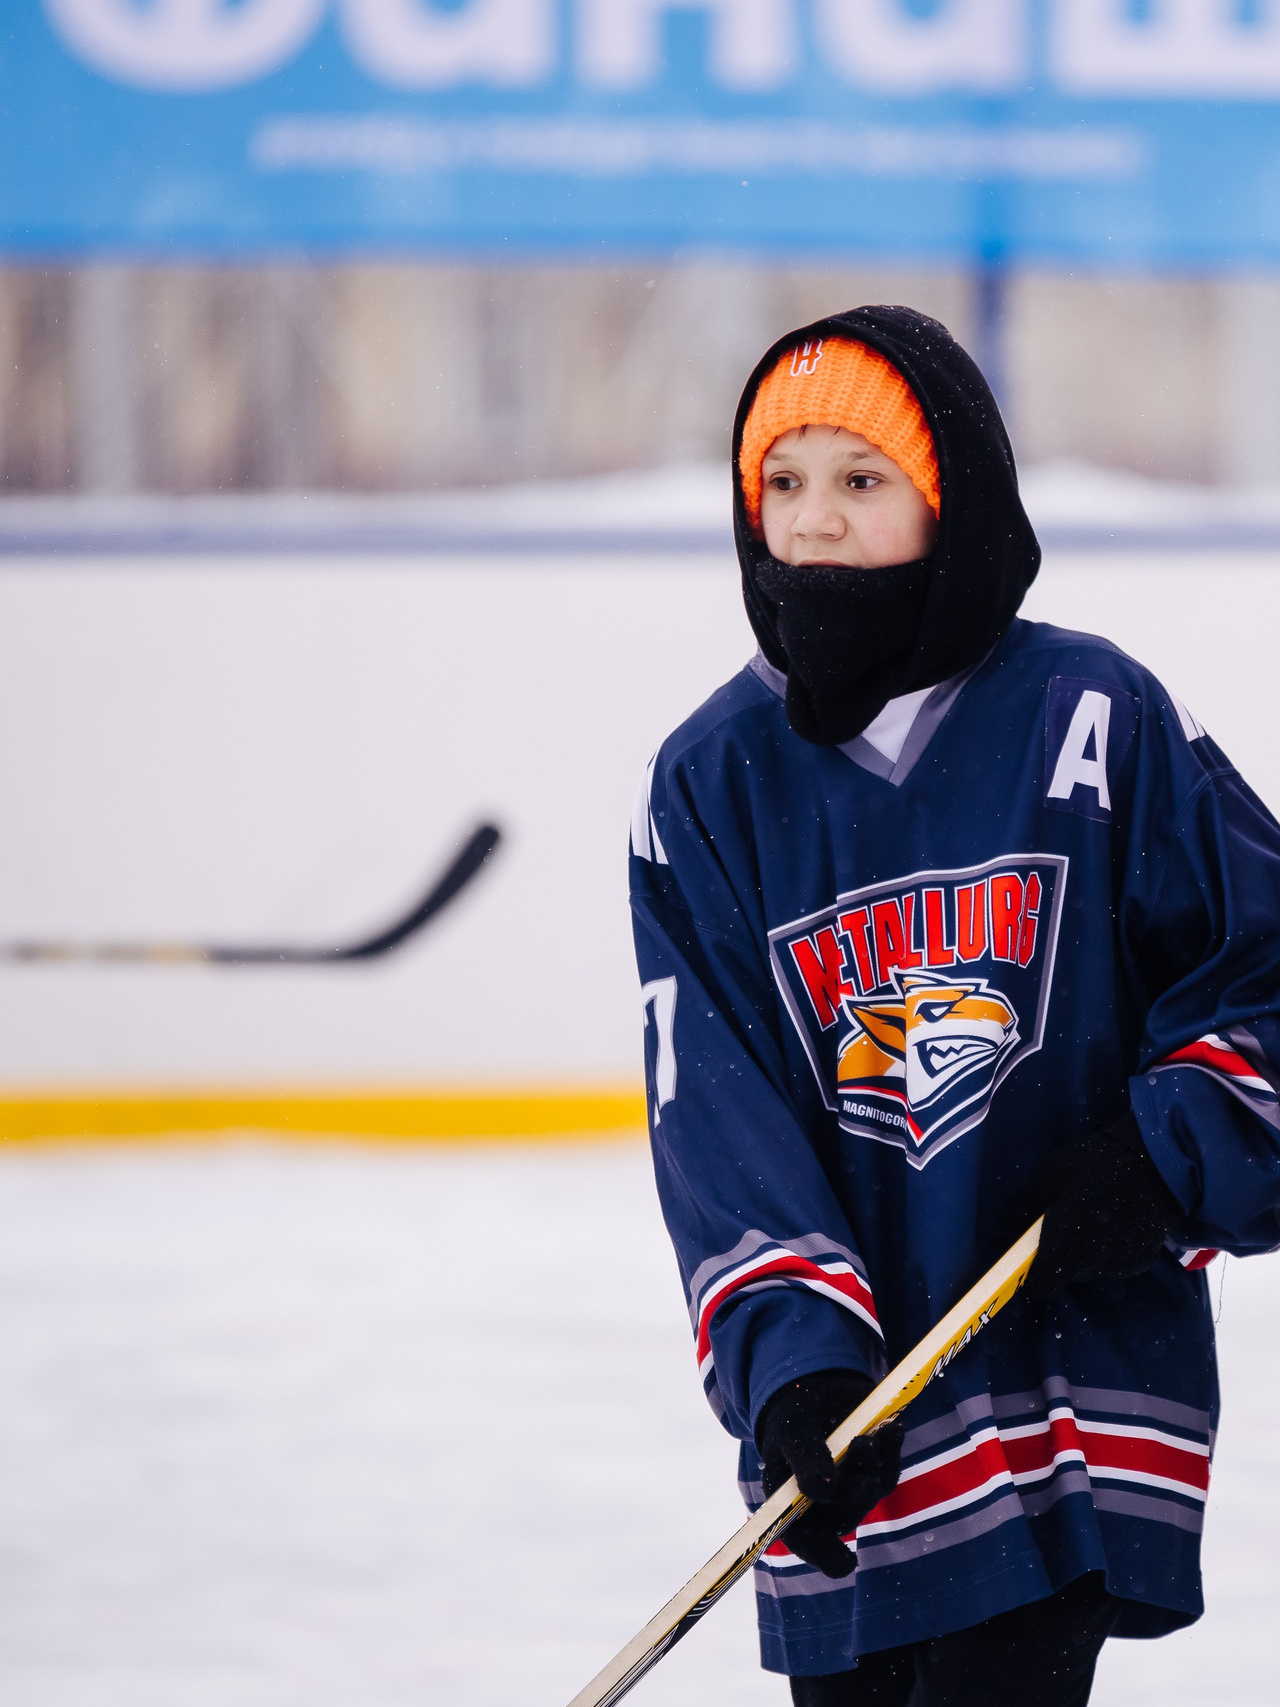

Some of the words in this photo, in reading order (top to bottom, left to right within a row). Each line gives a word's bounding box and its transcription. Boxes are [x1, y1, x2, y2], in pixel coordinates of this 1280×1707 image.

[1047, 689, 1112, 812] A
[787, 871, 1043, 1033] METALLURG
[843, 1099, 908, 1134] MAGNITOGOR
